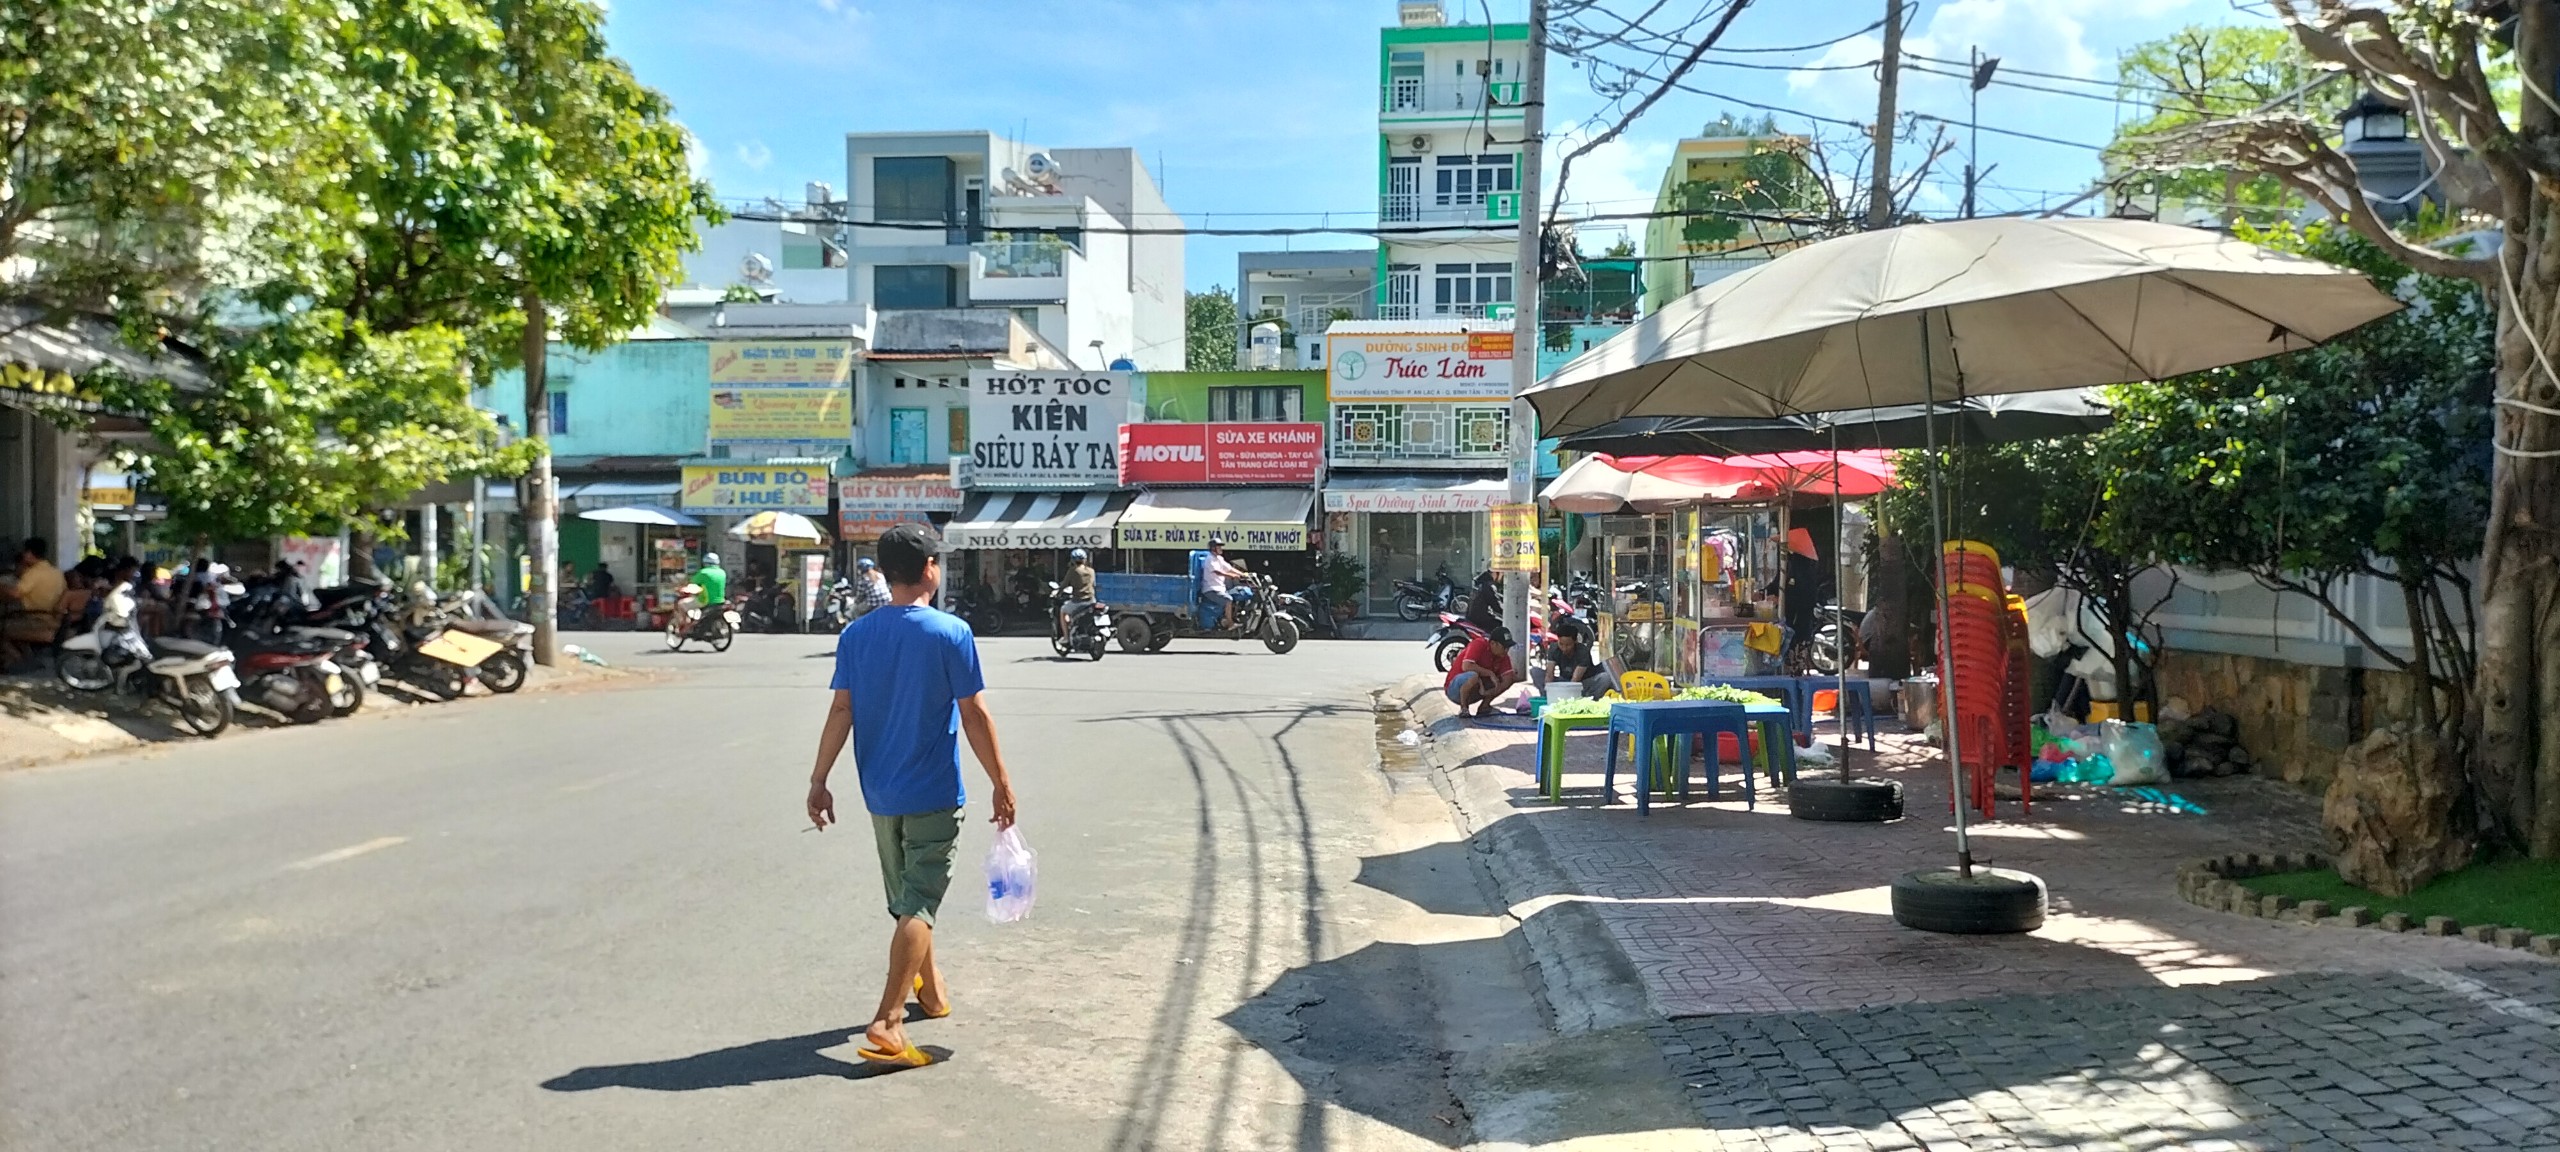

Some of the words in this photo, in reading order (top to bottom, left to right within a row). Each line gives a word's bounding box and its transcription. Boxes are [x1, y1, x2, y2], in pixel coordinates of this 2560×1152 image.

[1415, 342, 1448, 353] SINH
[1384, 357, 1429, 378] Trúc
[1436, 357, 1486, 378] Lâm
[986, 373, 1045, 395] HỚT
[1053, 373, 1112, 396] TÓC
[1012, 398, 1087, 431] KIÊN
[1216, 429, 1245, 444] SỬA
[1248, 432, 1265, 444] XE
[1268, 429, 1316, 444] KHÁNH
[974, 433, 1025, 469] SIÊU
[1032, 433, 1080, 470] RÁY
[1134, 445, 1205, 462] MOTUL
[1257, 452, 1283, 460] HONDA
[1237, 461, 1261, 469] TRANG
[1298, 461, 1308, 469] XE
[1347, 494, 1370, 510] Spa
[1419, 495, 1447, 508] Sinh
[969, 529, 1009, 546] NHỔ
[1016, 533, 1056, 546] TÓC
[1124, 525, 1142, 542] SỬA
[1144, 529, 1157, 542] XE
[1165, 525, 1186, 543] RỬA
[1188, 530, 1200, 542] XE
[1224, 525, 1239, 543] VỎ
[1247, 531, 1272, 544] THAY
[1274, 527, 1302, 544] NHỚT
[1516, 541, 1536, 555] 25K
